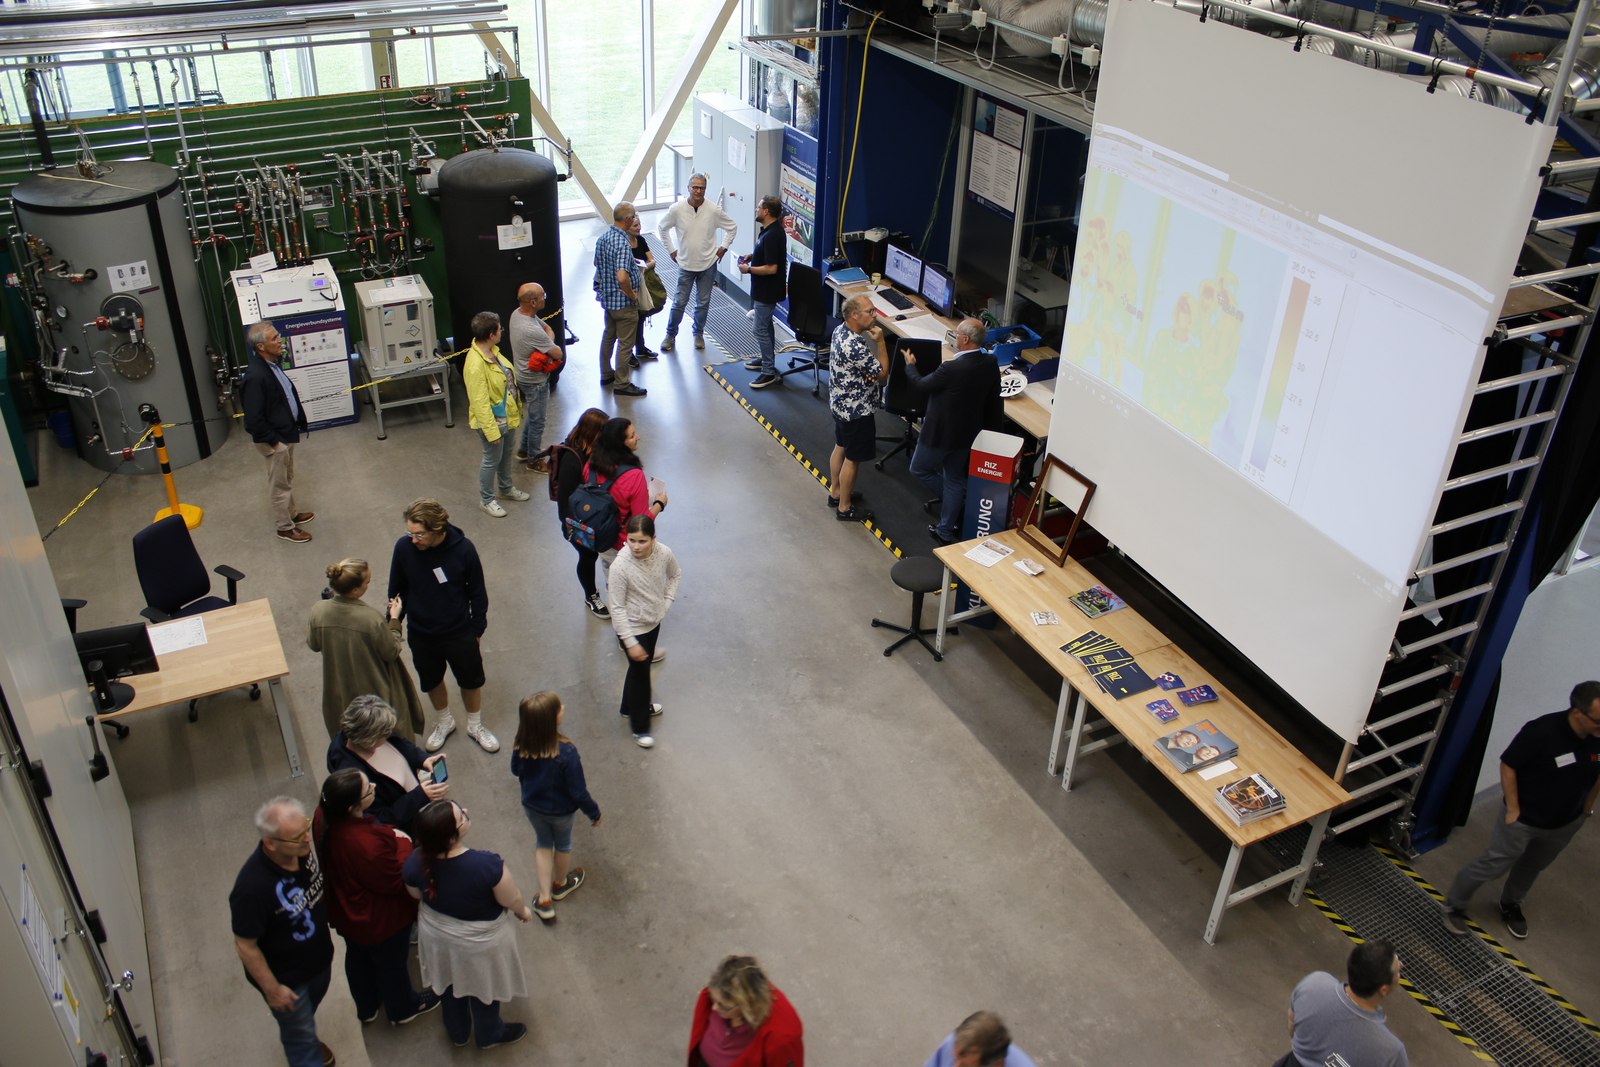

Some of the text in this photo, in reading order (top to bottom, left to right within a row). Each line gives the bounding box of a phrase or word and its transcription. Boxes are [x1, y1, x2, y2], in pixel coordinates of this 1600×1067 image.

[1312, 296, 1322, 306] 35
[285, 316, 342, 329] Energieverbundsysteme
[1304, 328, 1319, 343] 32.5
[1296, 361, 1305, 372] 30
[1288, 392, 1303, 407] 27.5
[1280, 424, 1289, 435] 25
[984, 460, 998, 470] RIZ
[1273, 454, 1287, 468] 22.5
[977, 467, 1003, 478] ENERGIE
[1107, 670, 1123, 682] RIZ
